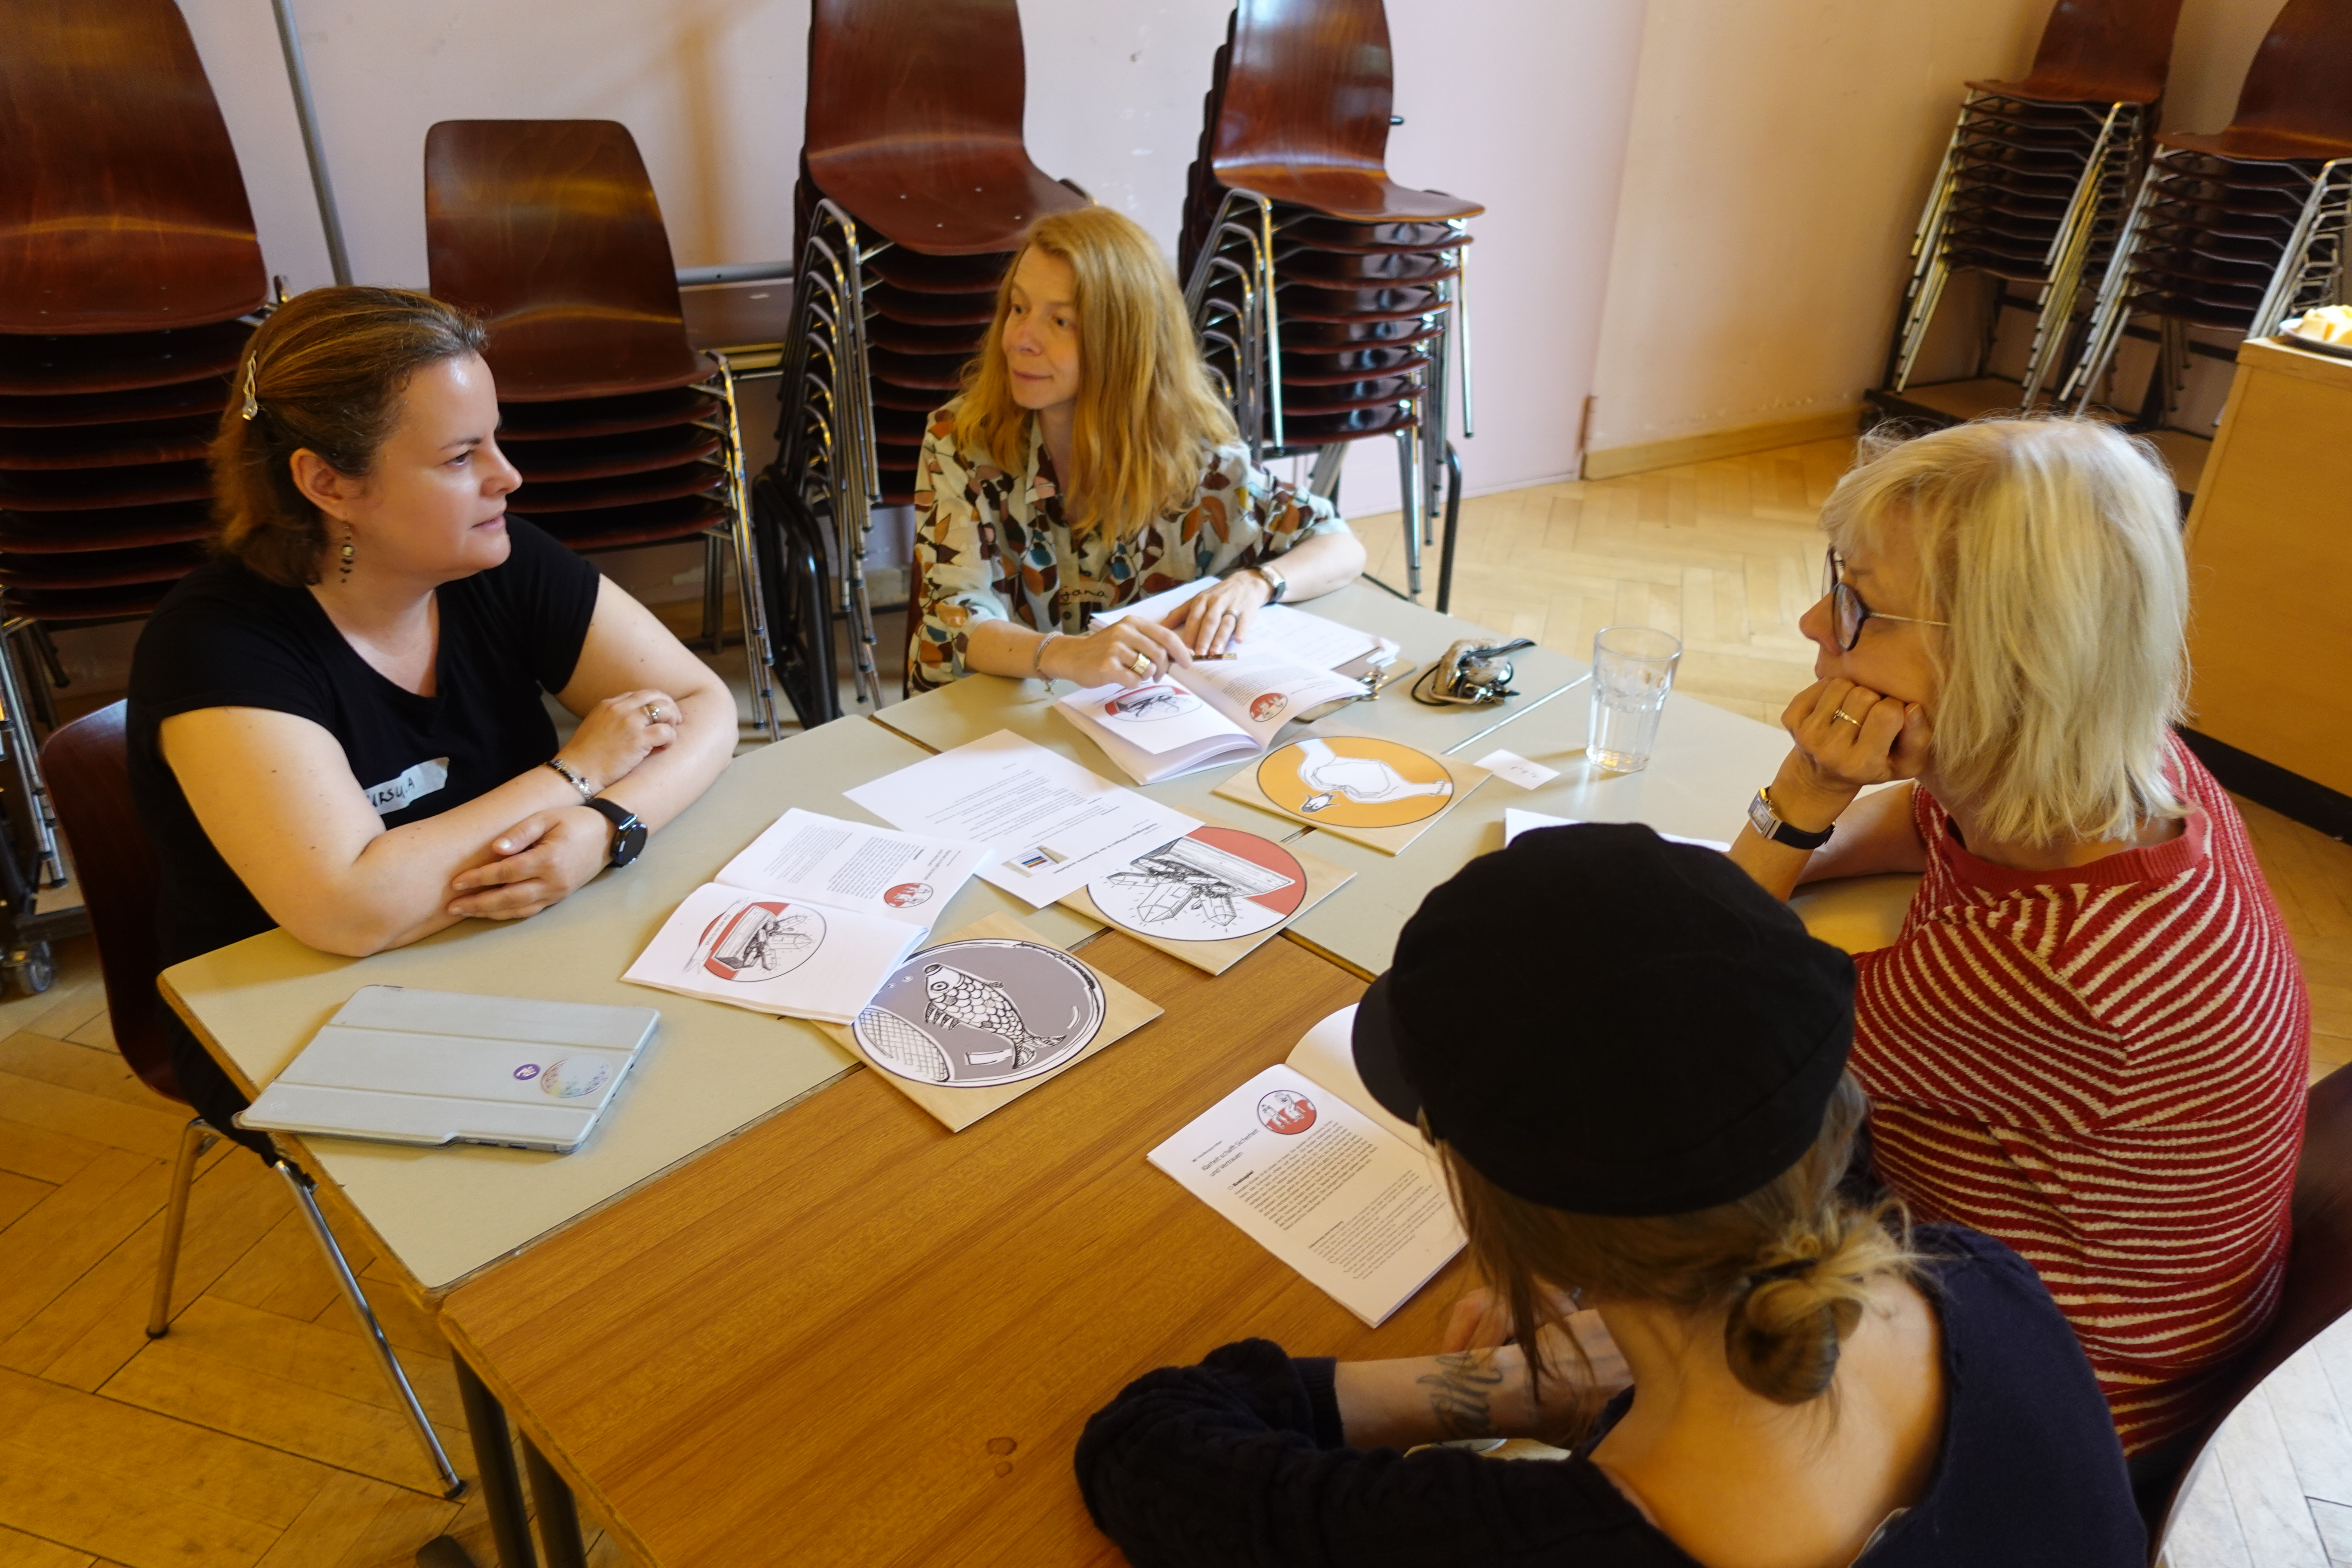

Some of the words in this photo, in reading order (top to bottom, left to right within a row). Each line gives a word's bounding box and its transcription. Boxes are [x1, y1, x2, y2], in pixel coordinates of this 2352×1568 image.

[1200, 1155, 1222, 1171] Klarheit
[1218, 1144, 1237, 1158] schafft
[1234, 1127, 1260, 1146] Sicherheit
[1208, 1167, 1222, 1177] und
[1218, 1150, 1244, 1170] Vertrauen
[1231, 1169, 1256, 1187] Kreisspiel
